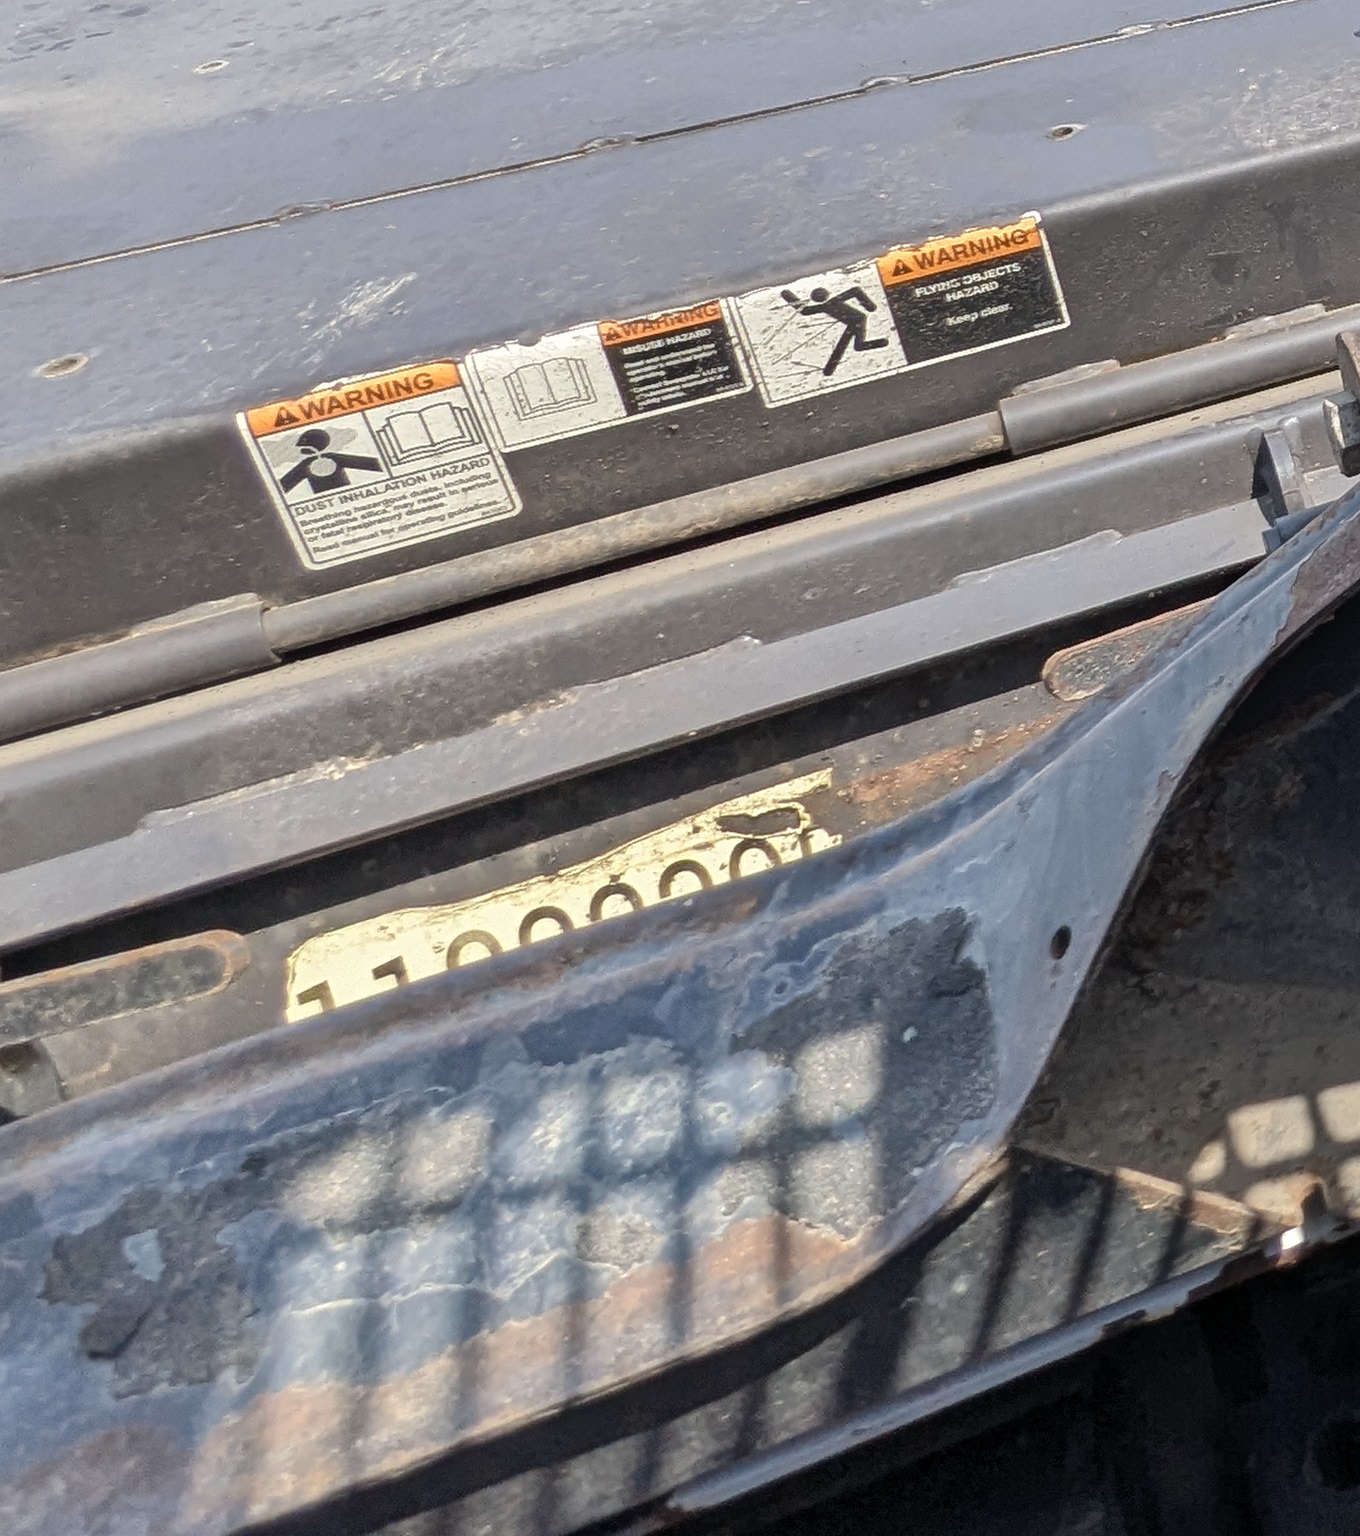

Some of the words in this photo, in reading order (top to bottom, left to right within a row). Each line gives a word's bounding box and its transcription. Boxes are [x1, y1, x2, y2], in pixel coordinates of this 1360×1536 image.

[912, 229, 1029, 270] WARNING
[914, 279, 961, 297] FLYING
[962, 262, 1021, 285] OBJECTS
[945, 281, 999, 302] HAZARD
[947, 310, 979, 326] Keep
[666, 328, 712, 345] HAZARD
[299, 372, 434, 420] WARNING
[294, 497, 335, 516] DUST
[338, 474, 427, 505] INHALATION
[430, 457, 491, 480] HAZARD
